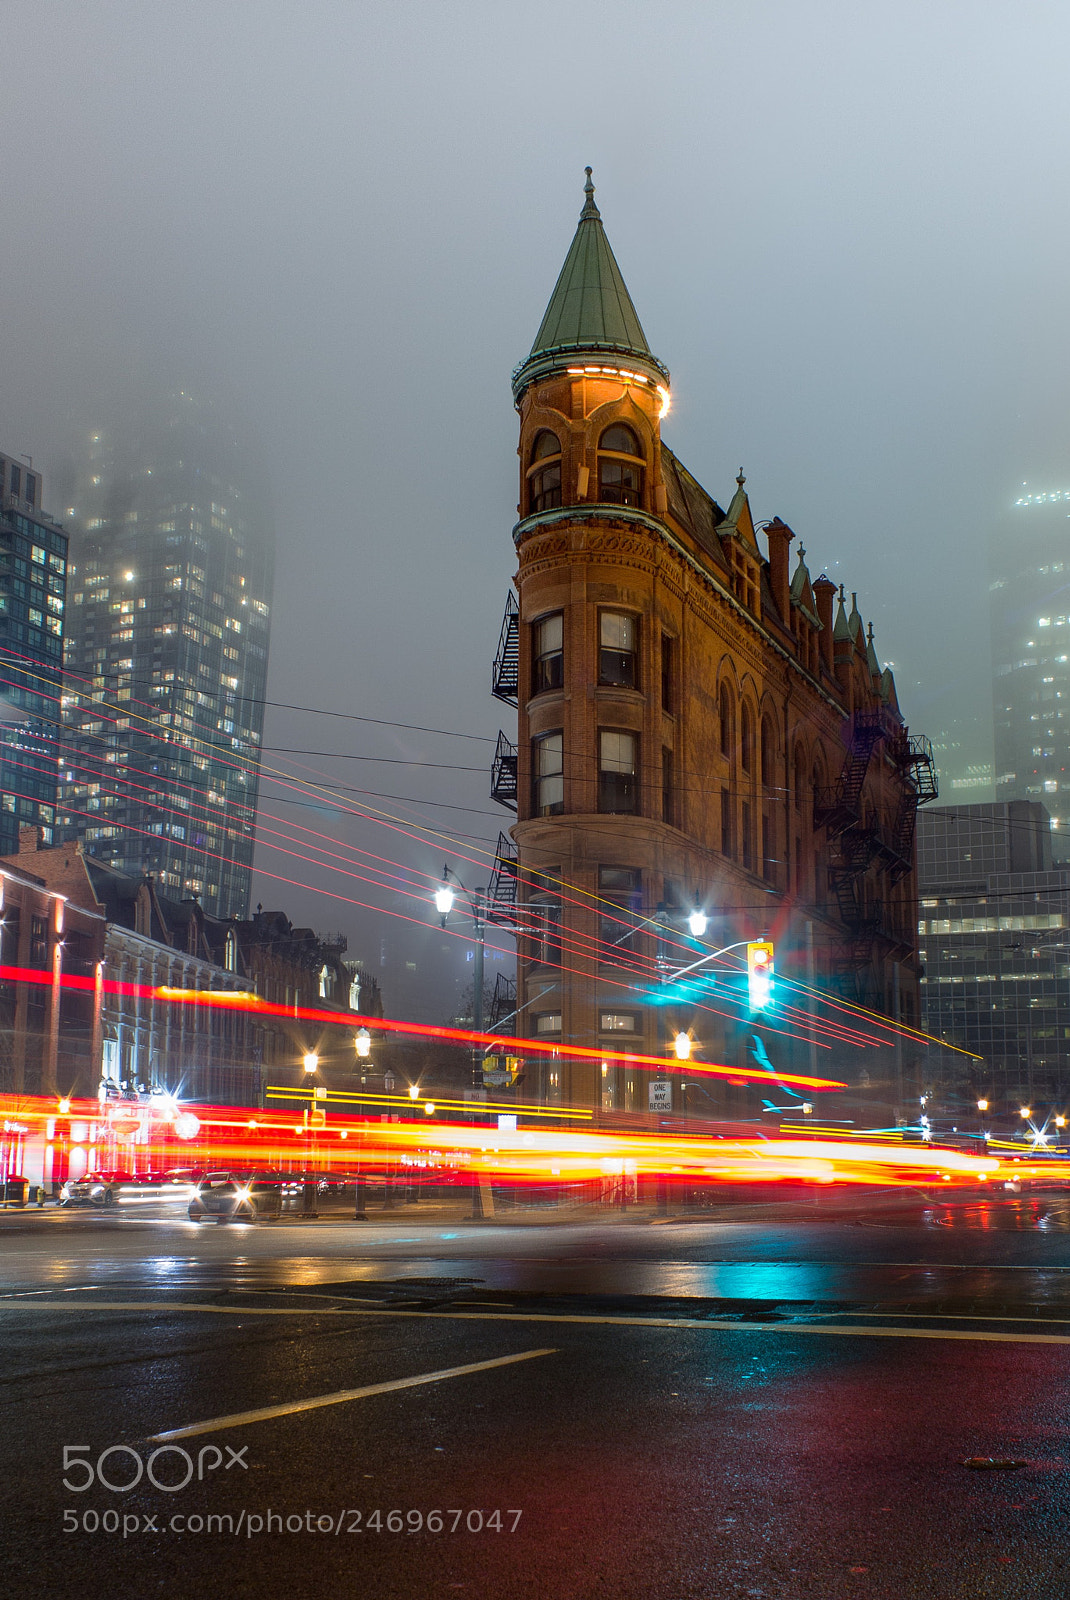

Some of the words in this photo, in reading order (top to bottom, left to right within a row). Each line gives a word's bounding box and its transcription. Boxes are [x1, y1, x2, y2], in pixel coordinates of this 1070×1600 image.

[654, 1084, 666, 1092] ONE
[654, 1093, 666, 1101] WAY
[650, 1102, 671, 1110] BEGINS
